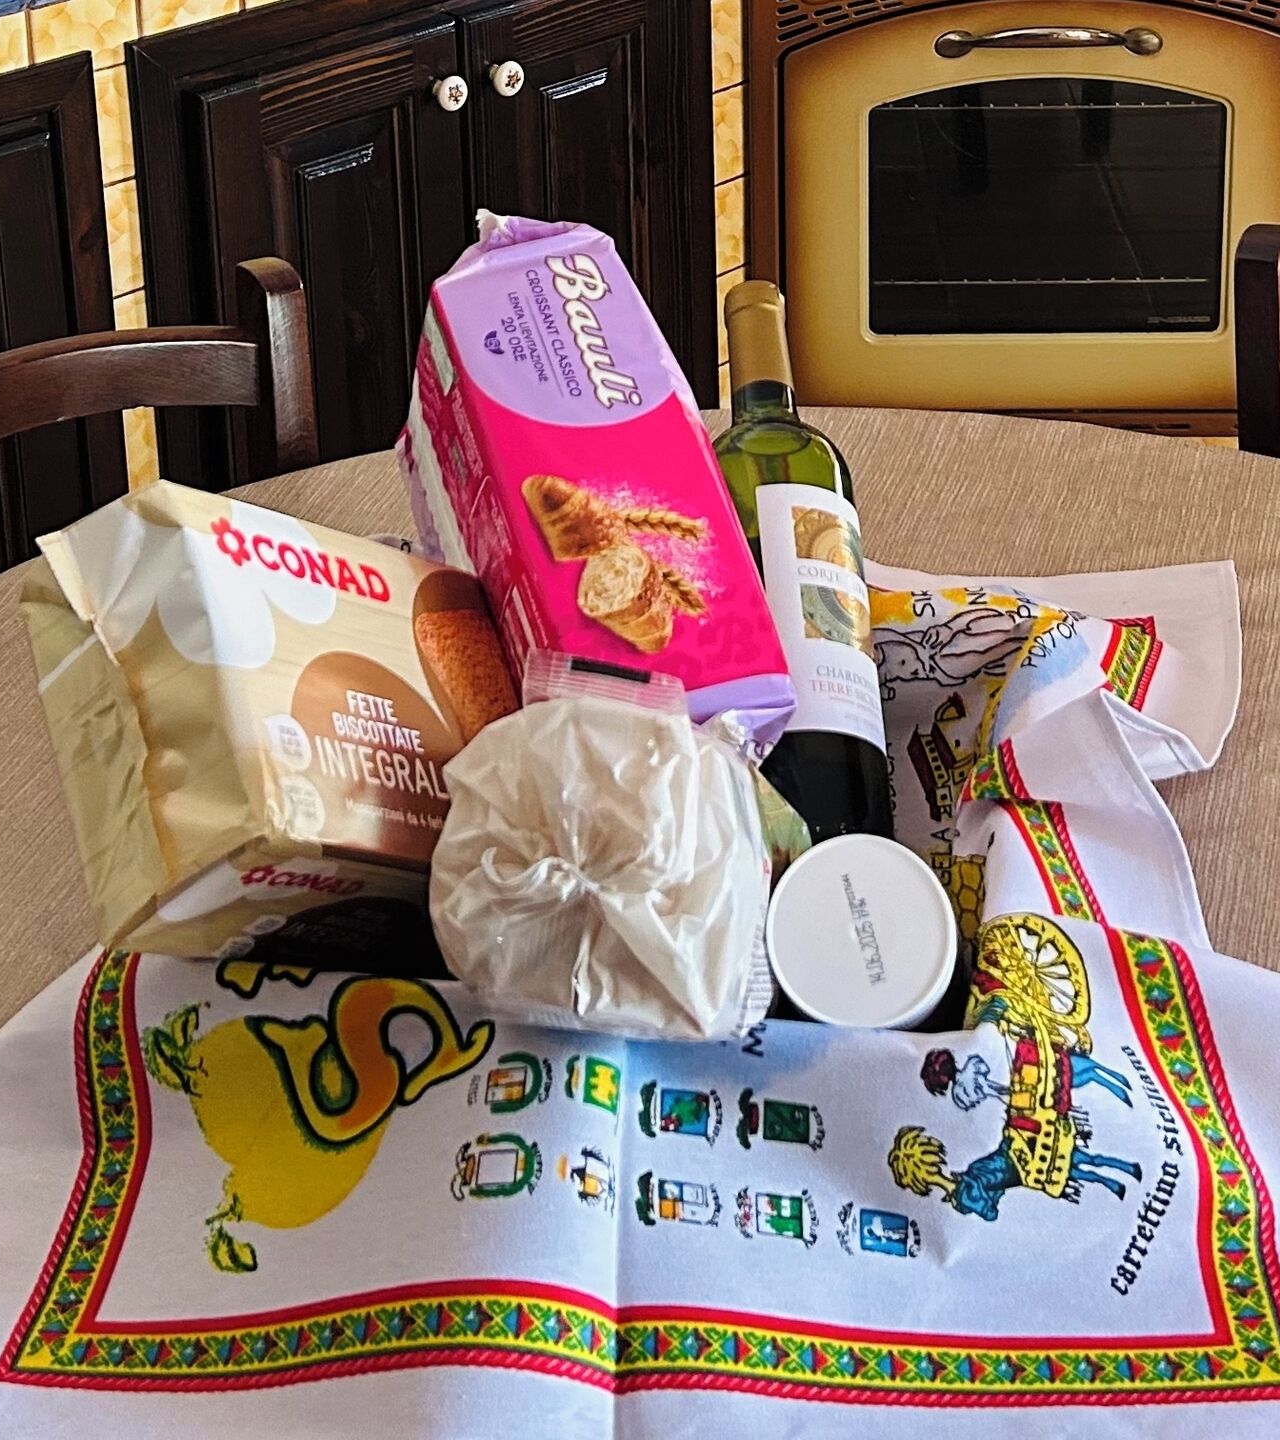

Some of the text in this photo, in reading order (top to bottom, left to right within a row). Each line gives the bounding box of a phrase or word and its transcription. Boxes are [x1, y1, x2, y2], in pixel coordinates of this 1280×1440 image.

[501, 317, 528, 362] 20 ORE
[525, 269, 582, 397] CROISSANT CLASSICO
[544, 253, 643, 410] Bauli
[252, 534, 391, 602] CONAD
[346, 689, 398, 725] FETTE
[809, 679, 853, 696] TERRE
[331, 711, 425, 755] BISCOTTATE
[314, 735, 451, 800] INTEGRAL
[269, 870, 364, 895] CONAD
[1110, 1045, 1184, 1296] carrettino siciliano
